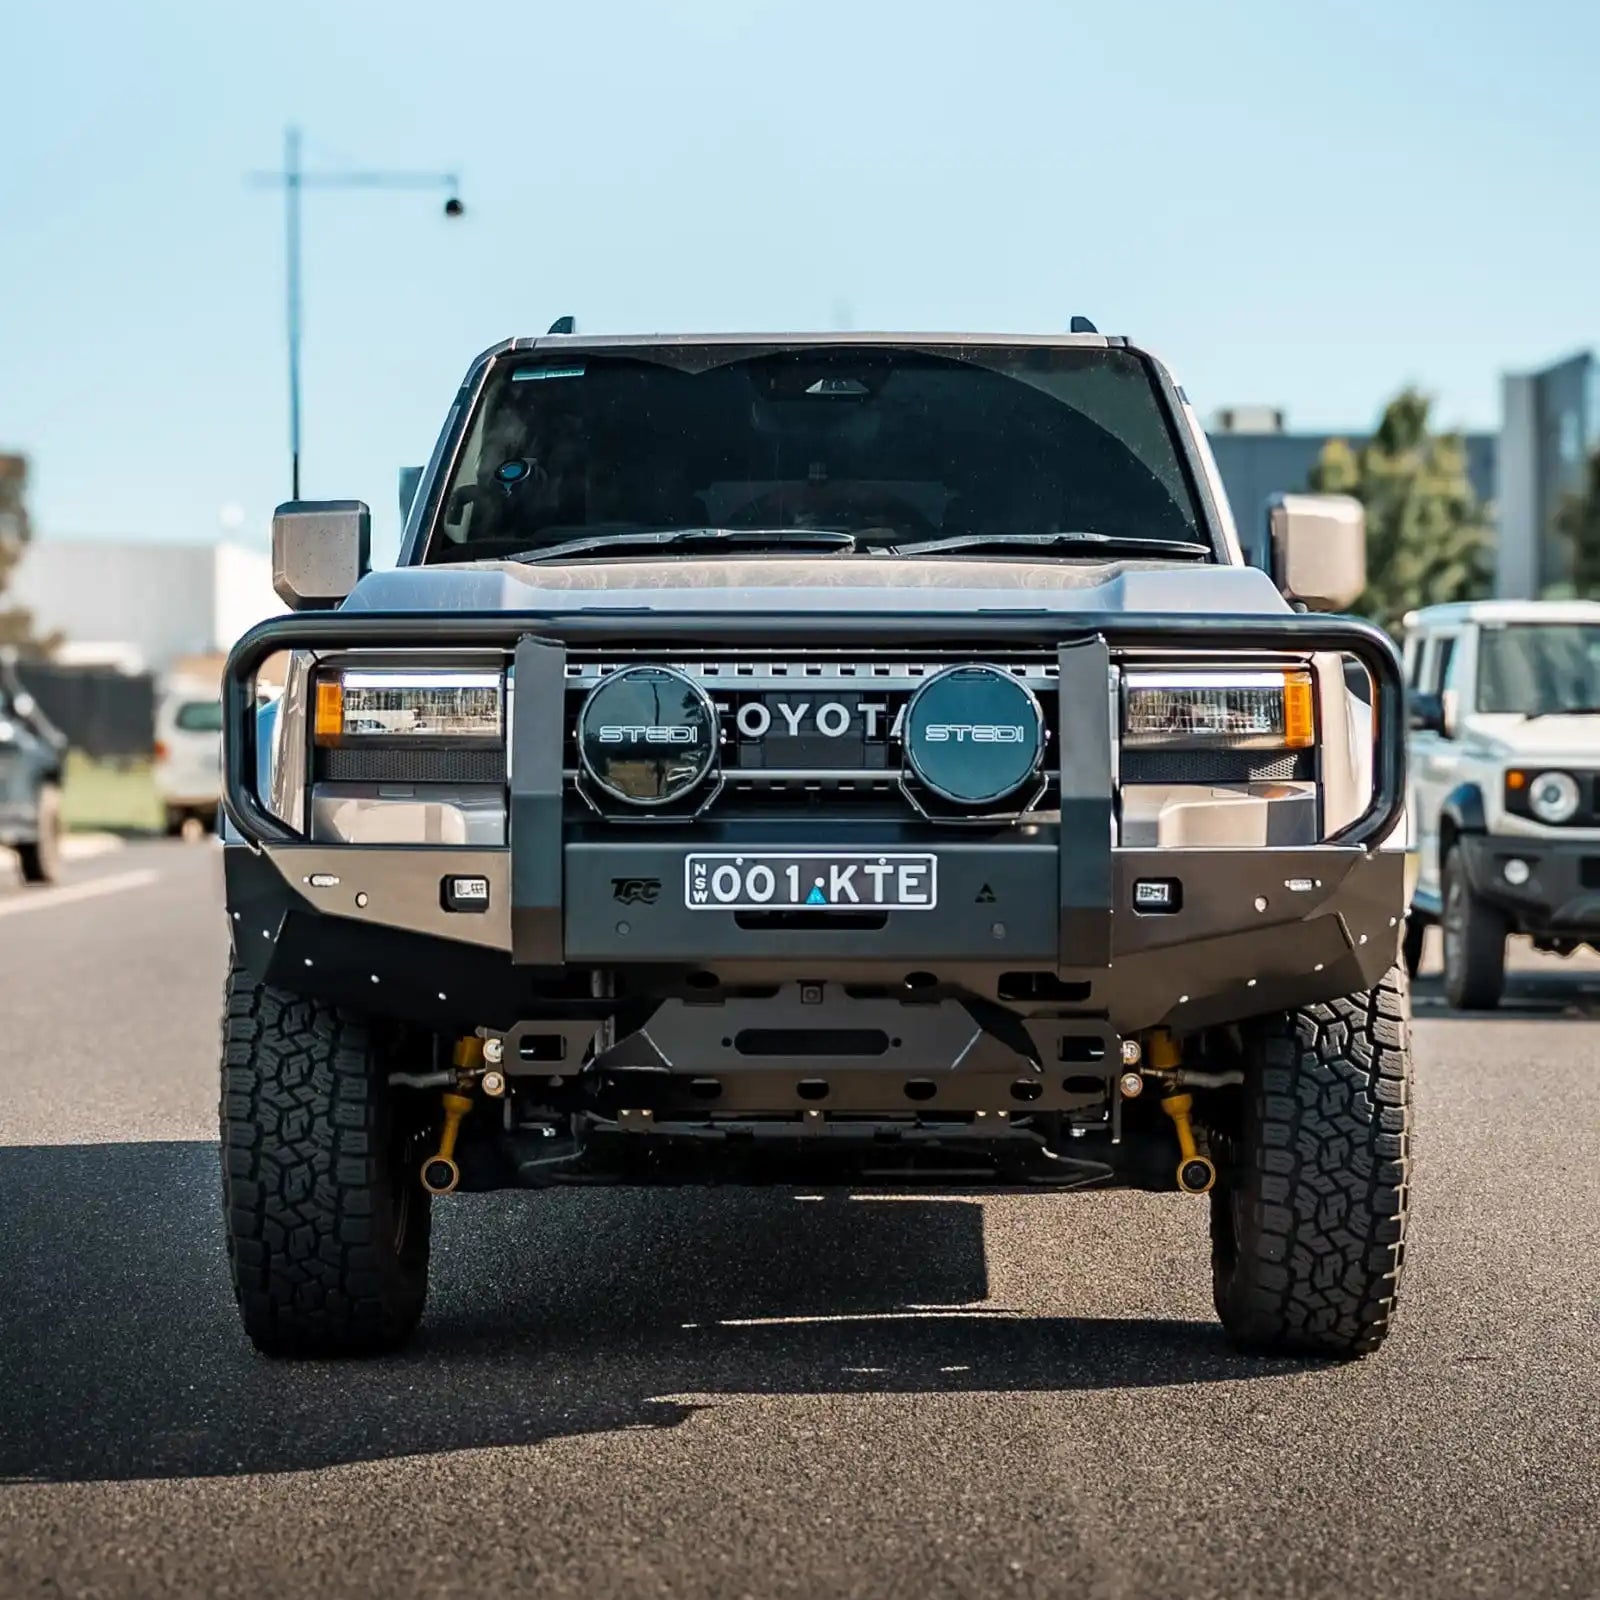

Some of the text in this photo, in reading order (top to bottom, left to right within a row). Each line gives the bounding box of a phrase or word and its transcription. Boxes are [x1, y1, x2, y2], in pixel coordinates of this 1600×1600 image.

[599, 725, 698, 743] STEDI
[925, 724, 1024, 743] STEDI
[693, 863, 708, 903] NSW
